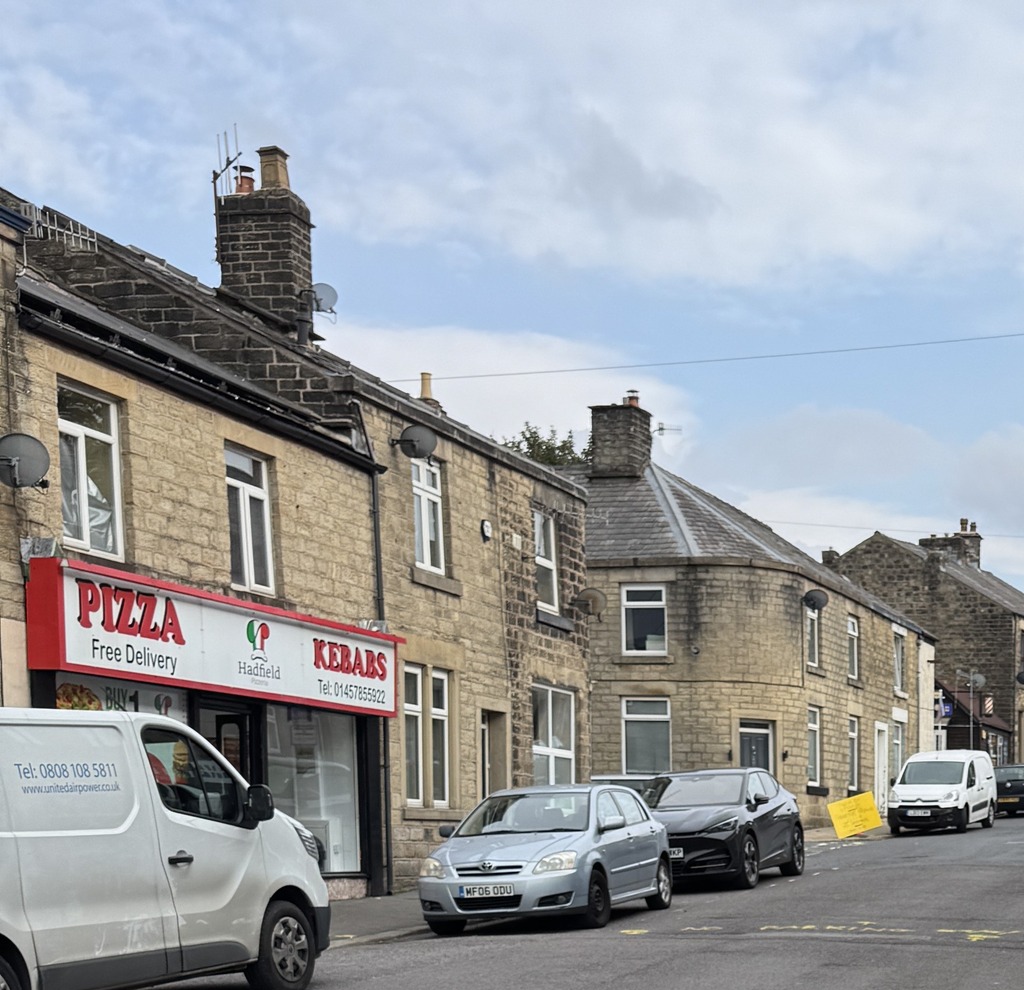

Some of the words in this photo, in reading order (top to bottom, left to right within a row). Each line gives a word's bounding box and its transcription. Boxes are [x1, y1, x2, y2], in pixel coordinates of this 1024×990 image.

[75, 577, 186, 645] PIZZA
[92, 638, 122, 662] Free
[126, 644, 178, 676] Delivery
[313, 638, 387, 682] KEBABS
[238, 661, 281, 680] Hadfield
[105, 686, 128, 710] BUY
[318, 679, 333, 696] Tel:
[334, 681, 386, 704] 01457855922
[14, 763, 38, 779] Tel:
[40, 763, 70, 779] 0808
[70, 763, 91, 778] 108
[93, 763, 118, 778] 5811
[21, 781, 121, 795] www.unitedairpower.co.uk
[465, 886, 490, 897] MF06
